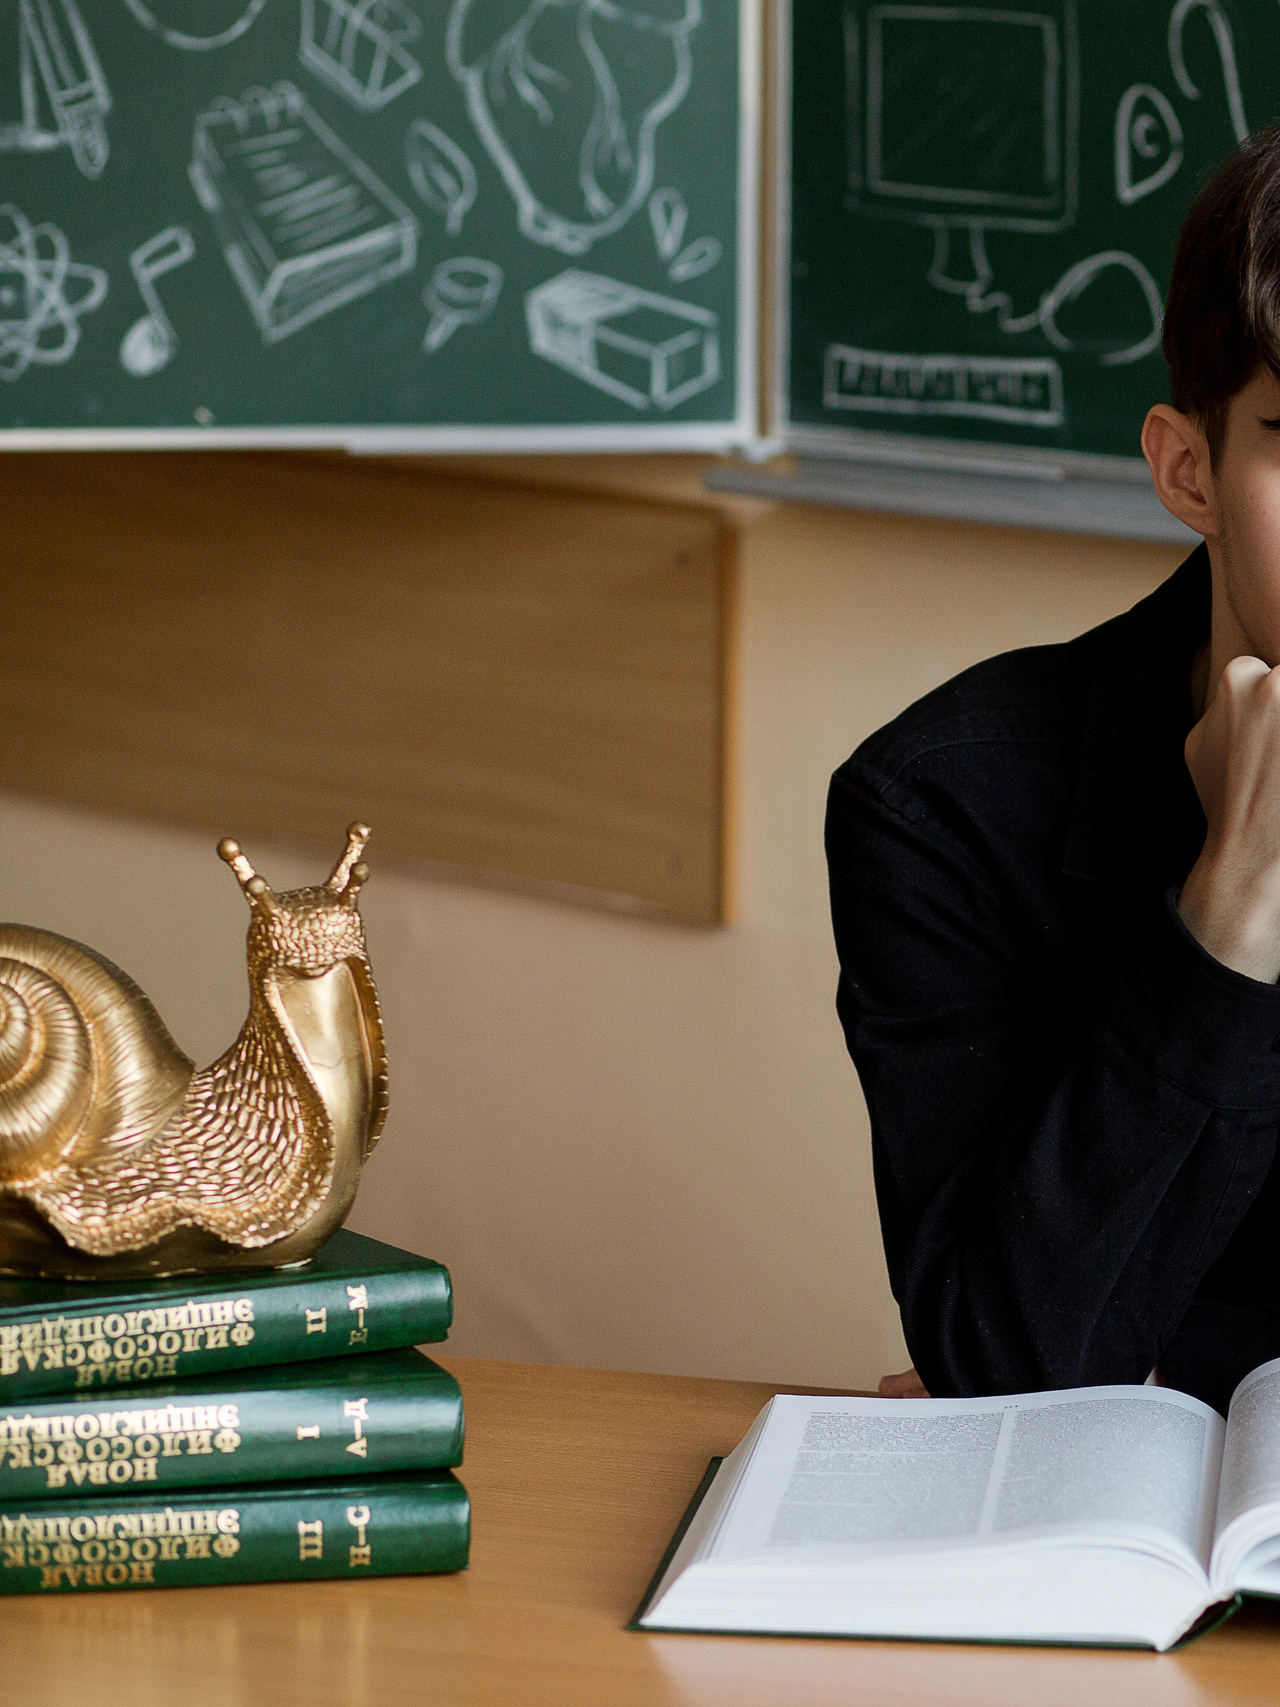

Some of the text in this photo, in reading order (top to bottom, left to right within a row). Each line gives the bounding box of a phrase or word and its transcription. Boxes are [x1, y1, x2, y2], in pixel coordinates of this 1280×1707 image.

[0, 1298, 255, 1350] ЭНЦИКЛОПЕДИЯ
[0, 1322, 255, 1376] ФИЛОСОФСКАЯ
[75, 1354, 180, 1387] НОВАЯ
[0, 1428, 242, 1469] ФИЛОСОФСК
[46, 1457, 158, 1488] НОВАЯ
[0, 1506, 241, 1544] ЭНЦИКЛОПЕД
[0, 1533, 241, 1569] ФИЛОСОФСК
[40, 1560, 156, 1588] НОВАЯ
